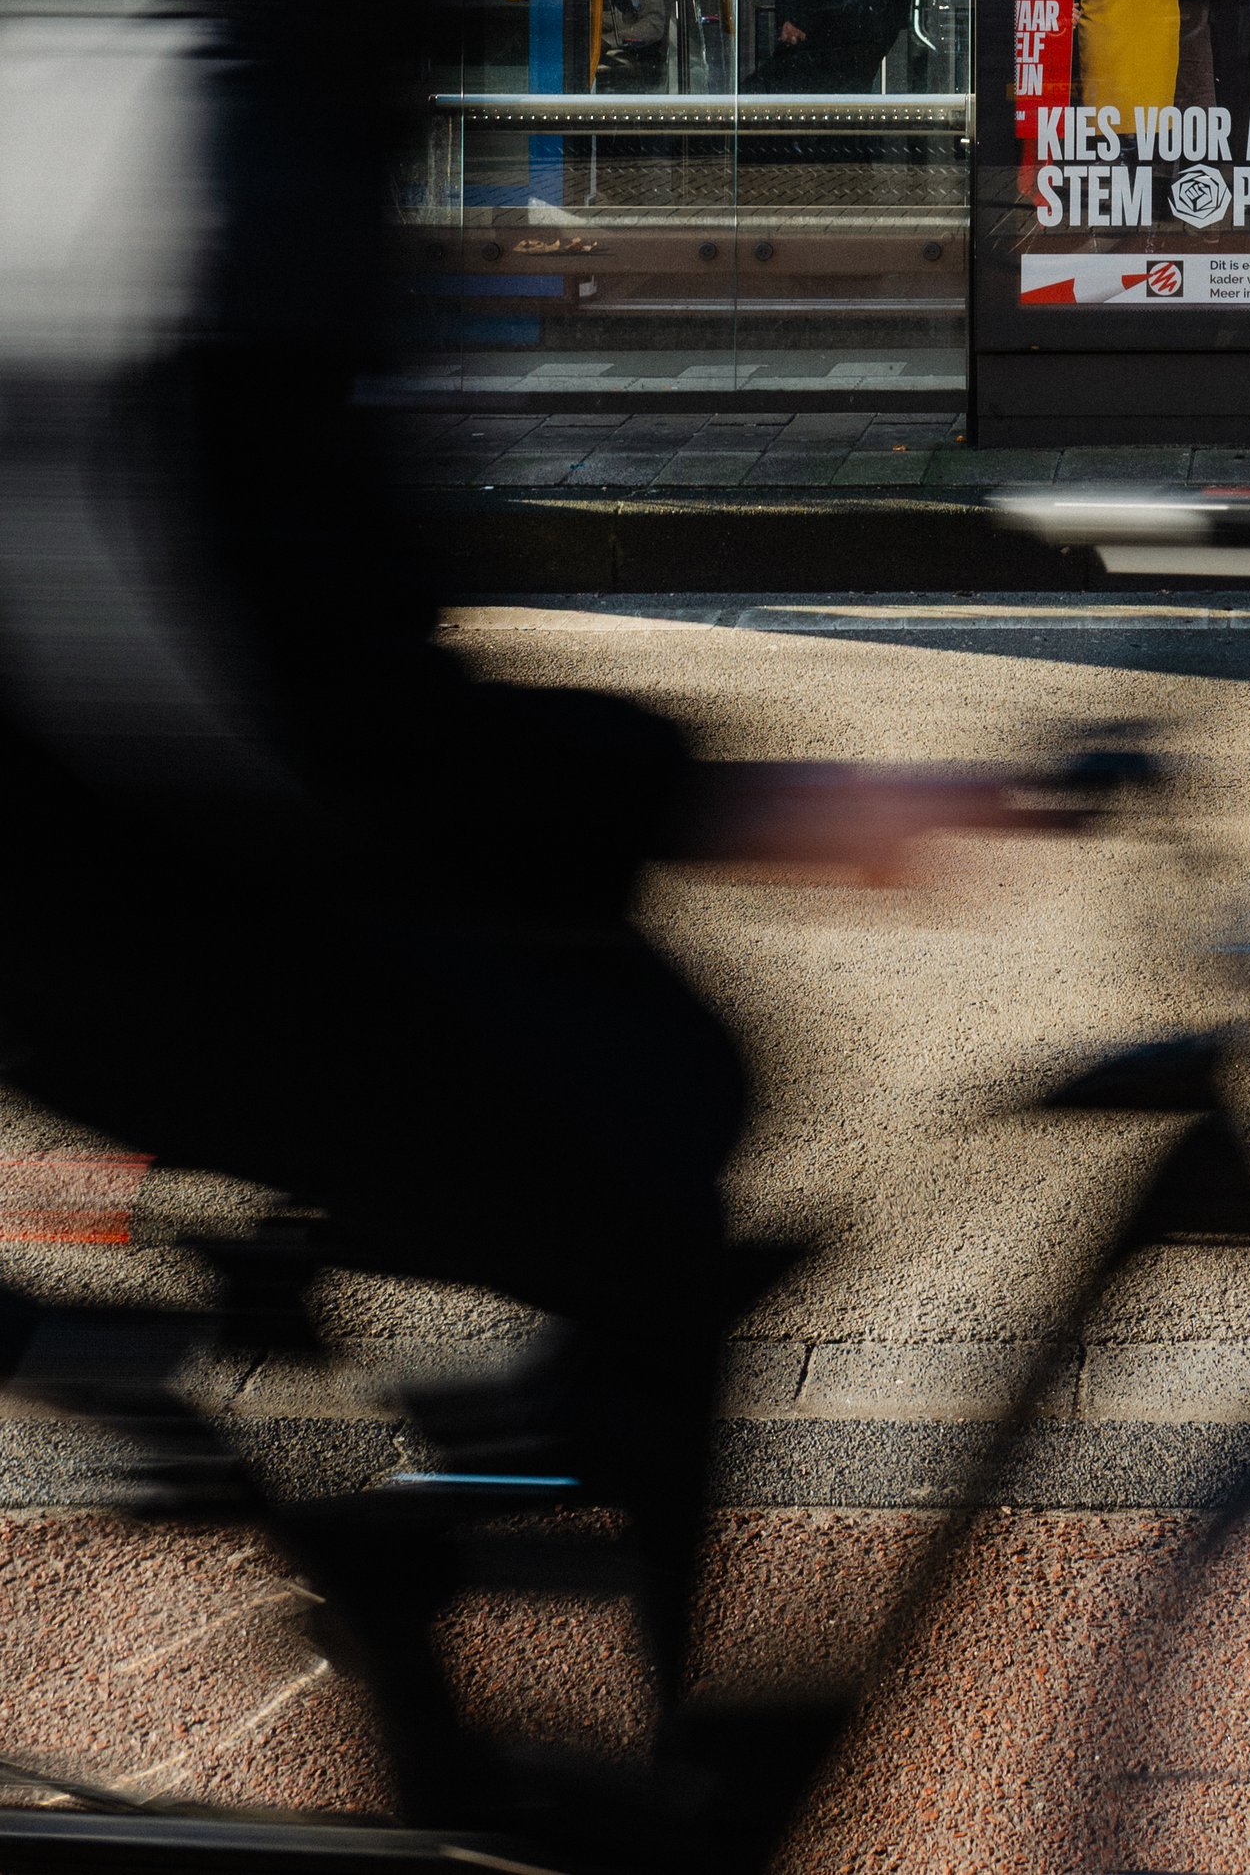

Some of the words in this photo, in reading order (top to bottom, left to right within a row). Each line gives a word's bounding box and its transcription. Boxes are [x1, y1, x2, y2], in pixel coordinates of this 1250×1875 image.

[1037, 105, 1121, 162] KIES
[1134, 105, 1233, 162] VOOR
[1036, 164, 1153, 228] STEM
[1209, 260, 1227, 271] Dit
[1230, 260, 1239, 271] is
[1209, 274, 1244, 285] kader
[1209, 288, 1241, 299] Meer
